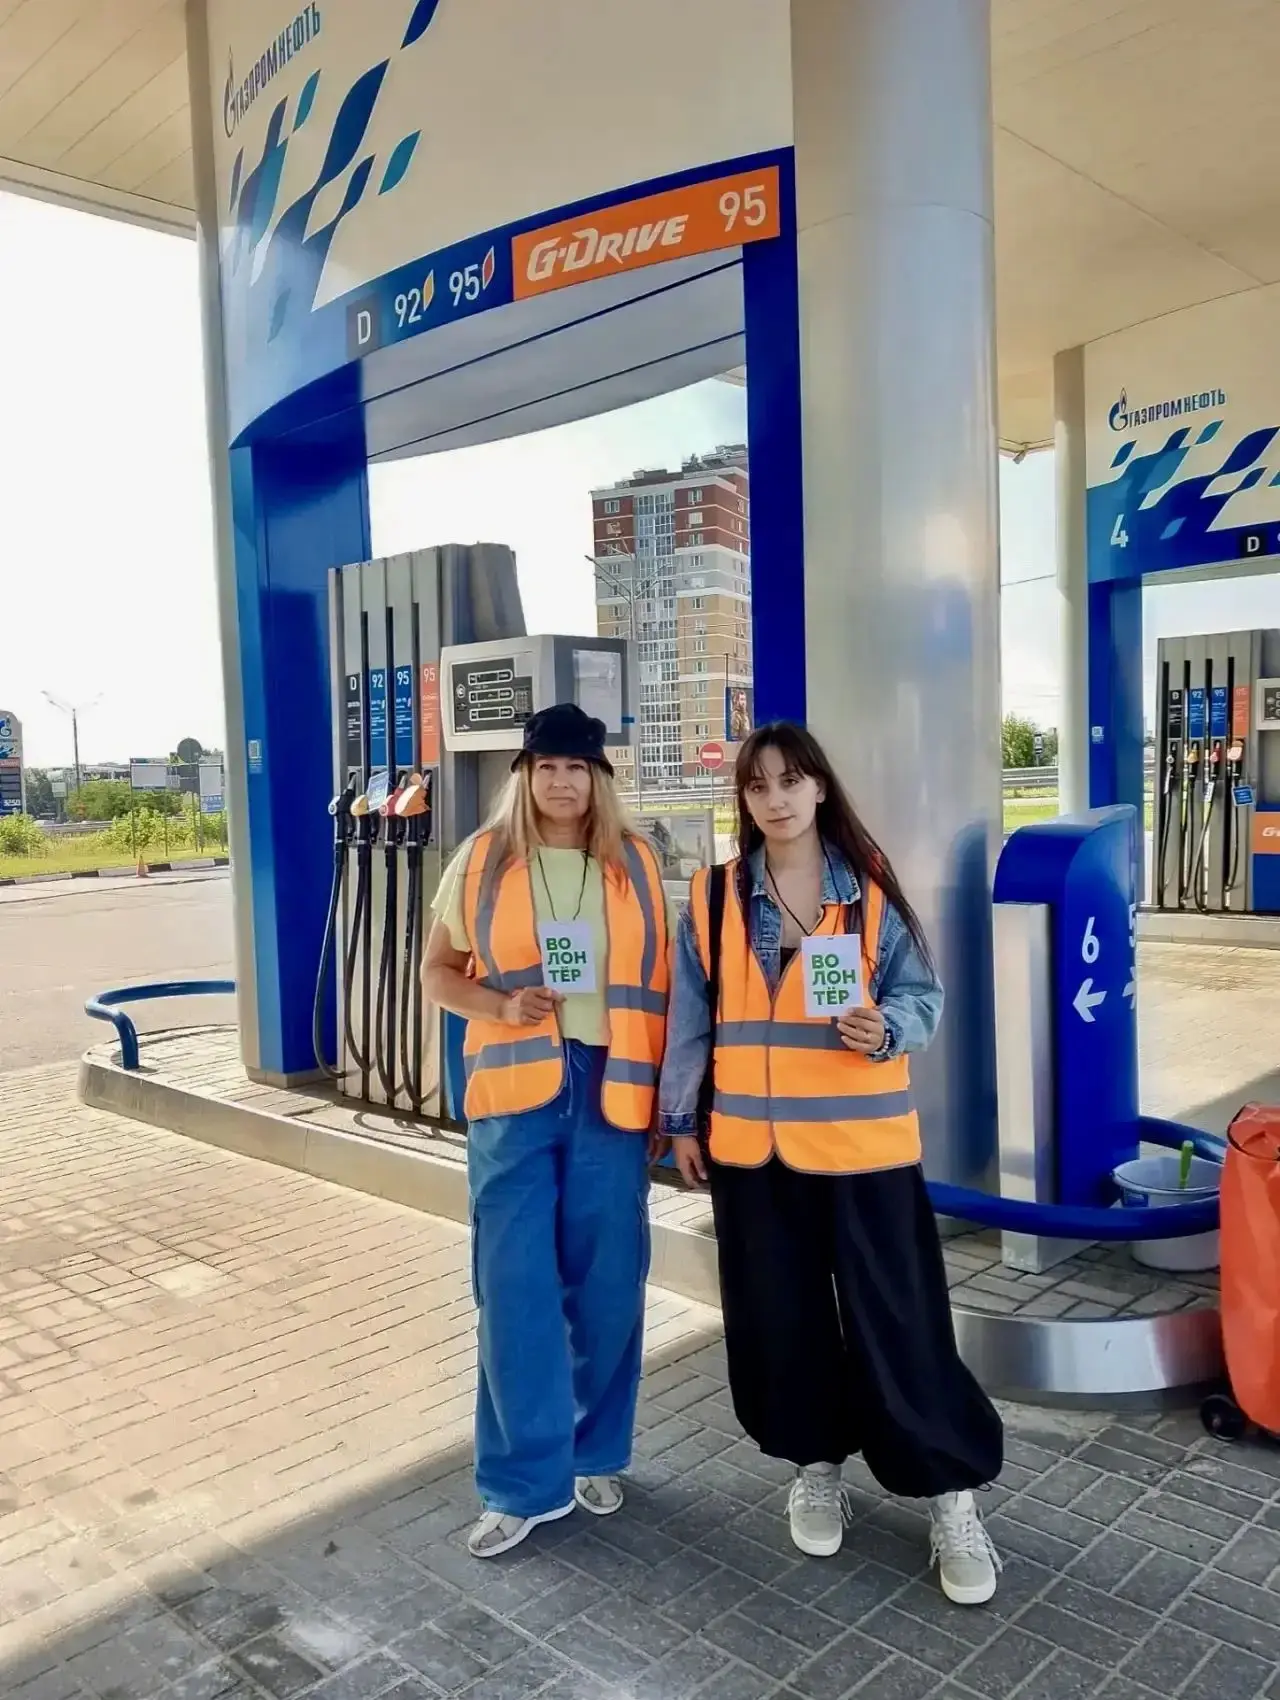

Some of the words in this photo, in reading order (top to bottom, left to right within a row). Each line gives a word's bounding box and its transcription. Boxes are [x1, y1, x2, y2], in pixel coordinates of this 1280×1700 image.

[236, 1, 320, 126] ГАЗПРОМНЕФТЬ
[357, 310, 371, 345] D
[394, 288, 421, 328] 92
[449, 263, 480, 306] 95
[718, 184, 766, 232] 95
[1128, 389, 1226, 428] ГАЗПРОМНЕФТЬ
[1110, 513, 1129, 548] 4
[1247, 536, 1260, 553] D
[350, 676, 357, 691] D
[371, 673, 384, 688] 92
[397, 670, 410, 685] 95
[423, 667, 436, 684] 95
[1192, 690, 1202, 699] 92
[1214, 689, 1224, 697] 95
[546, 937, 571, 950] ВО
[1081, 916, 1100, 964] 6
[547, 951, 587, 966] ЛОН
[811, 953, 839, 969] ВО
[548, 966, 581, 982] ТЁР
[812, 969, 856, 985] ЛОН
[813, 986, 850, 1005] ТЁР
